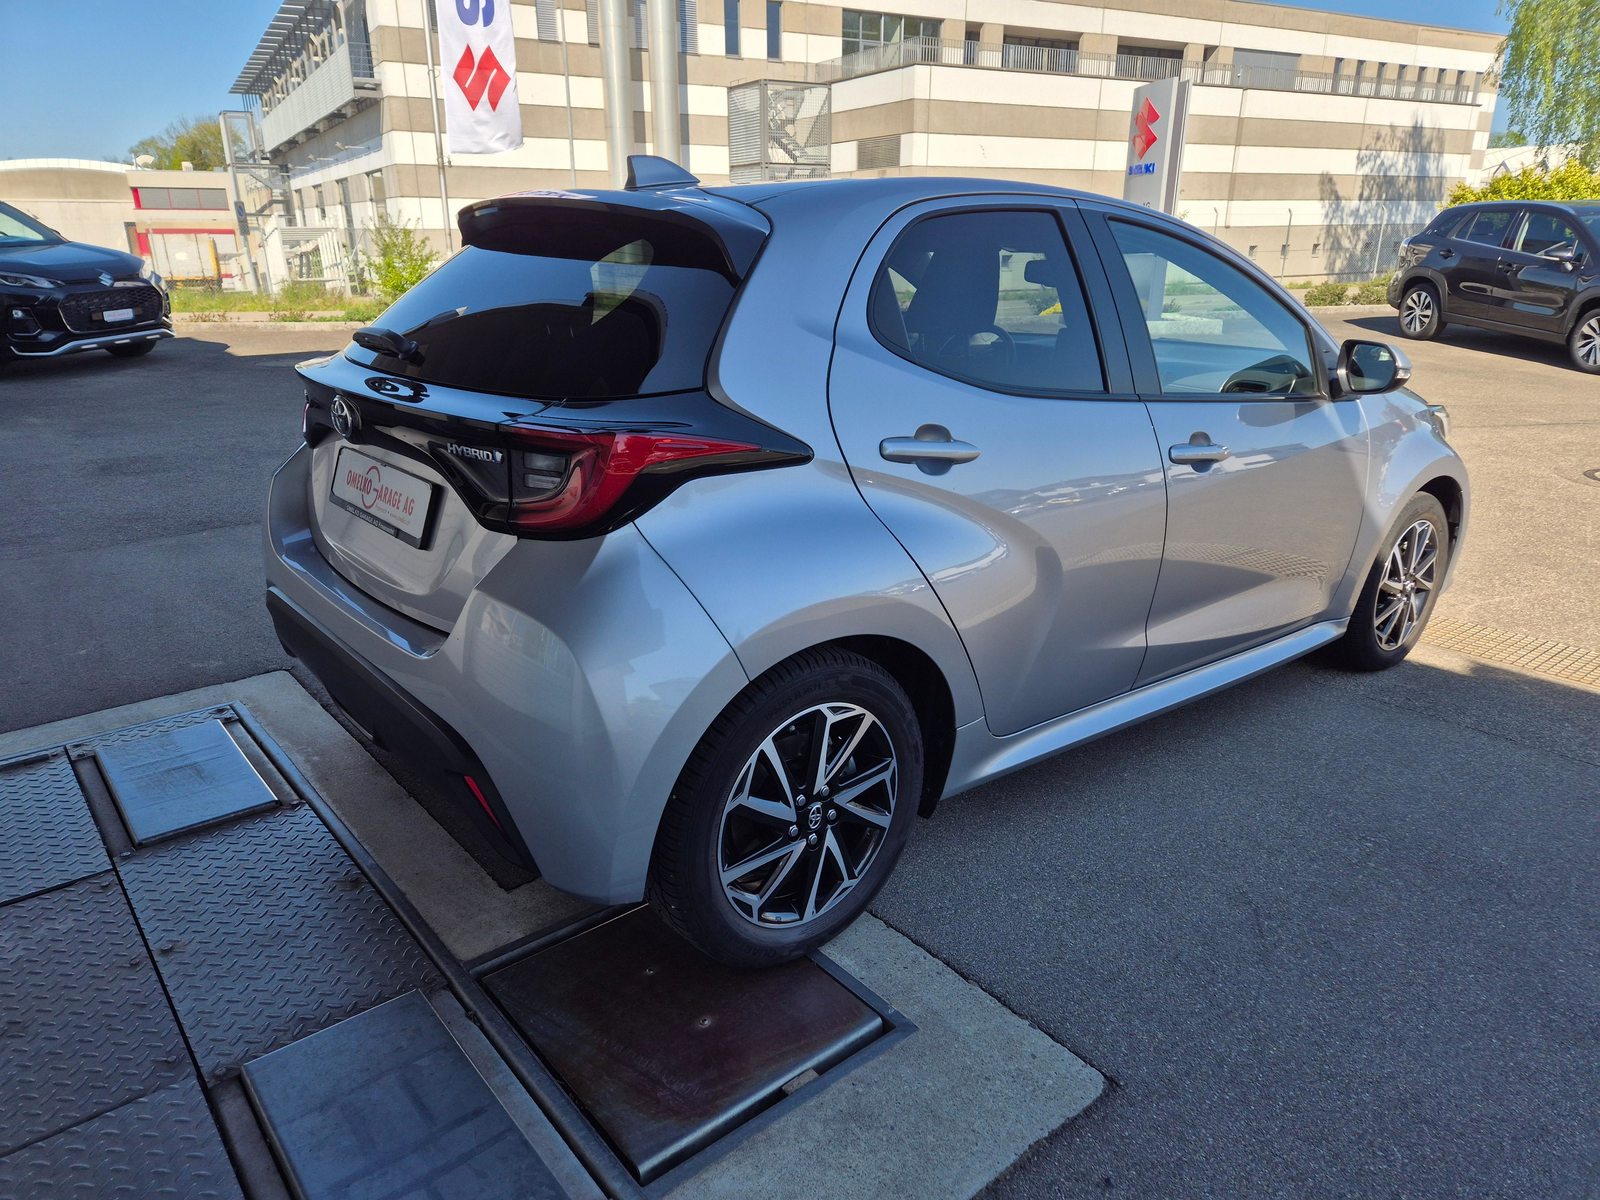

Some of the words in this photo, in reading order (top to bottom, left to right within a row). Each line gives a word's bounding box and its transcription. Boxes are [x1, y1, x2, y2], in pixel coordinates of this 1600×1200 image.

[447, 442, 493, 462] HYBRID
[346, 469, 373, 495] OMELKO
[402, 495, 415, 516] AG
